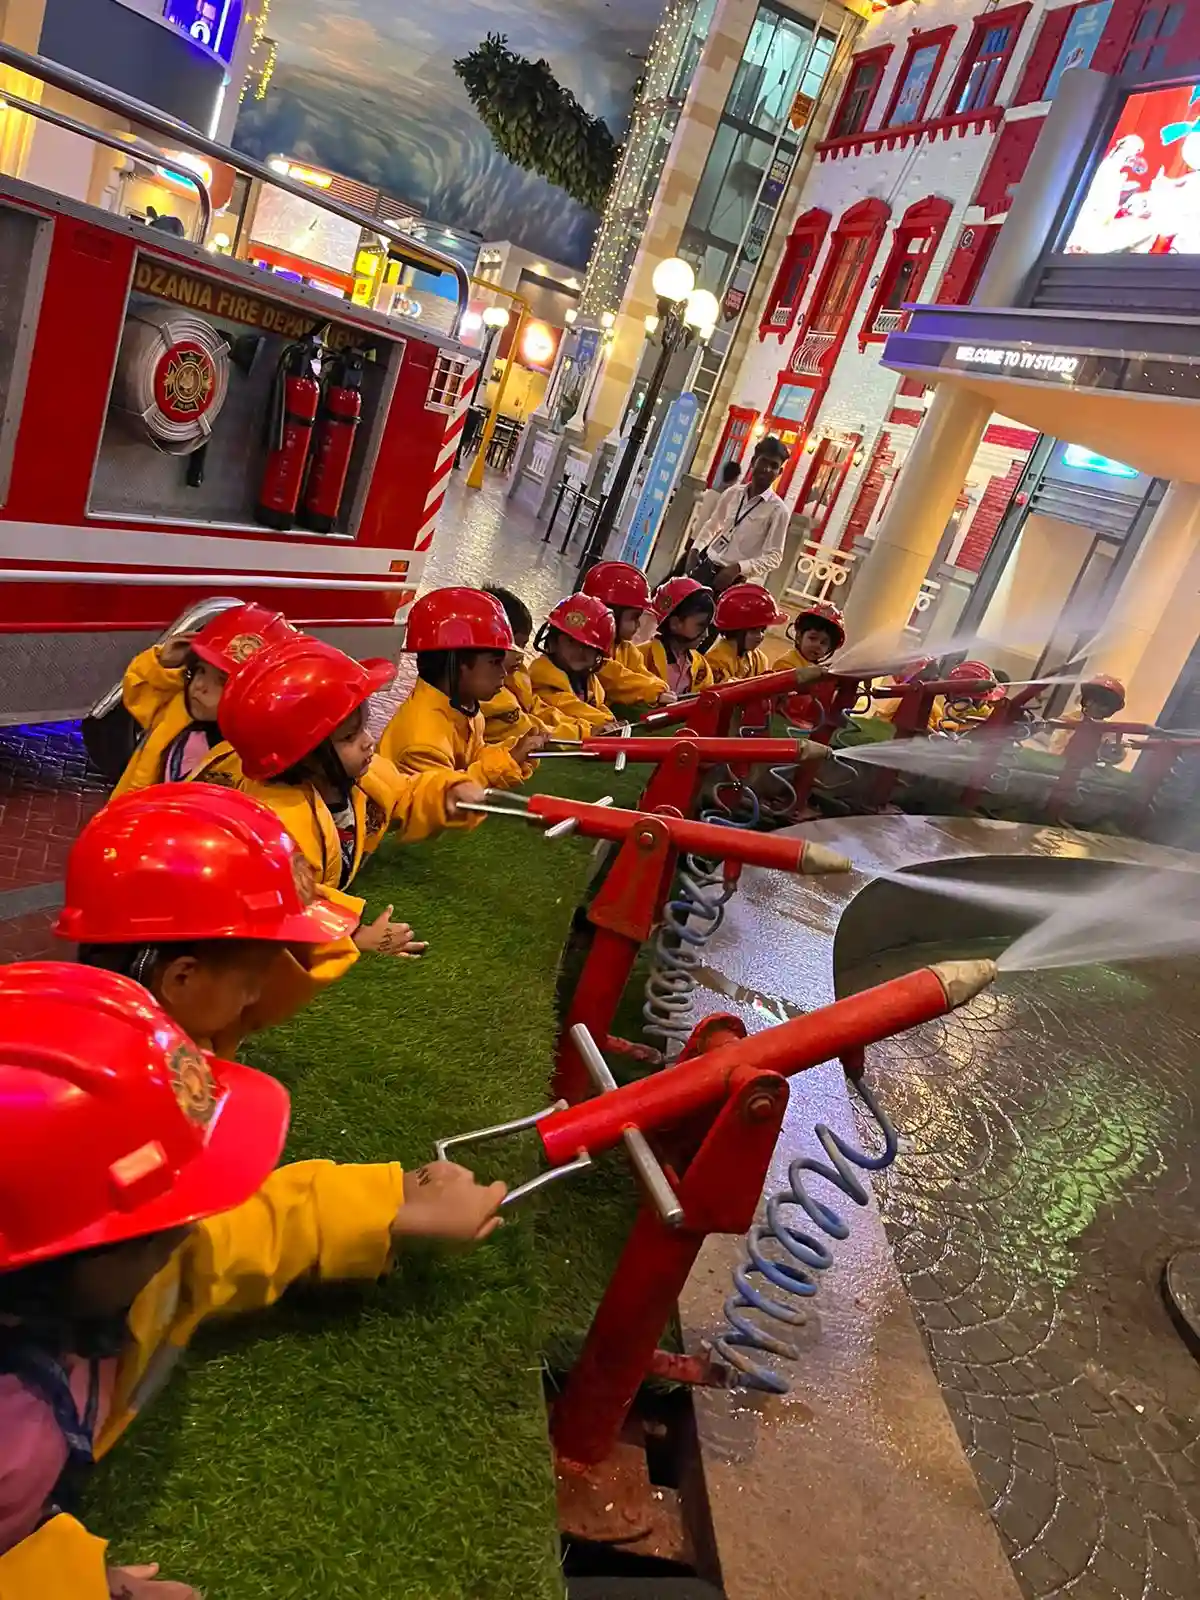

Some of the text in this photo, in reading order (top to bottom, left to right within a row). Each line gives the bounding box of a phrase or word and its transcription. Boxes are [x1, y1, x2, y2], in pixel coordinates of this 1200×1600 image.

[217, 290, 257, 324] FIRE
[955, 346, 1079, 373] WELCOME TO TV STUDIO
